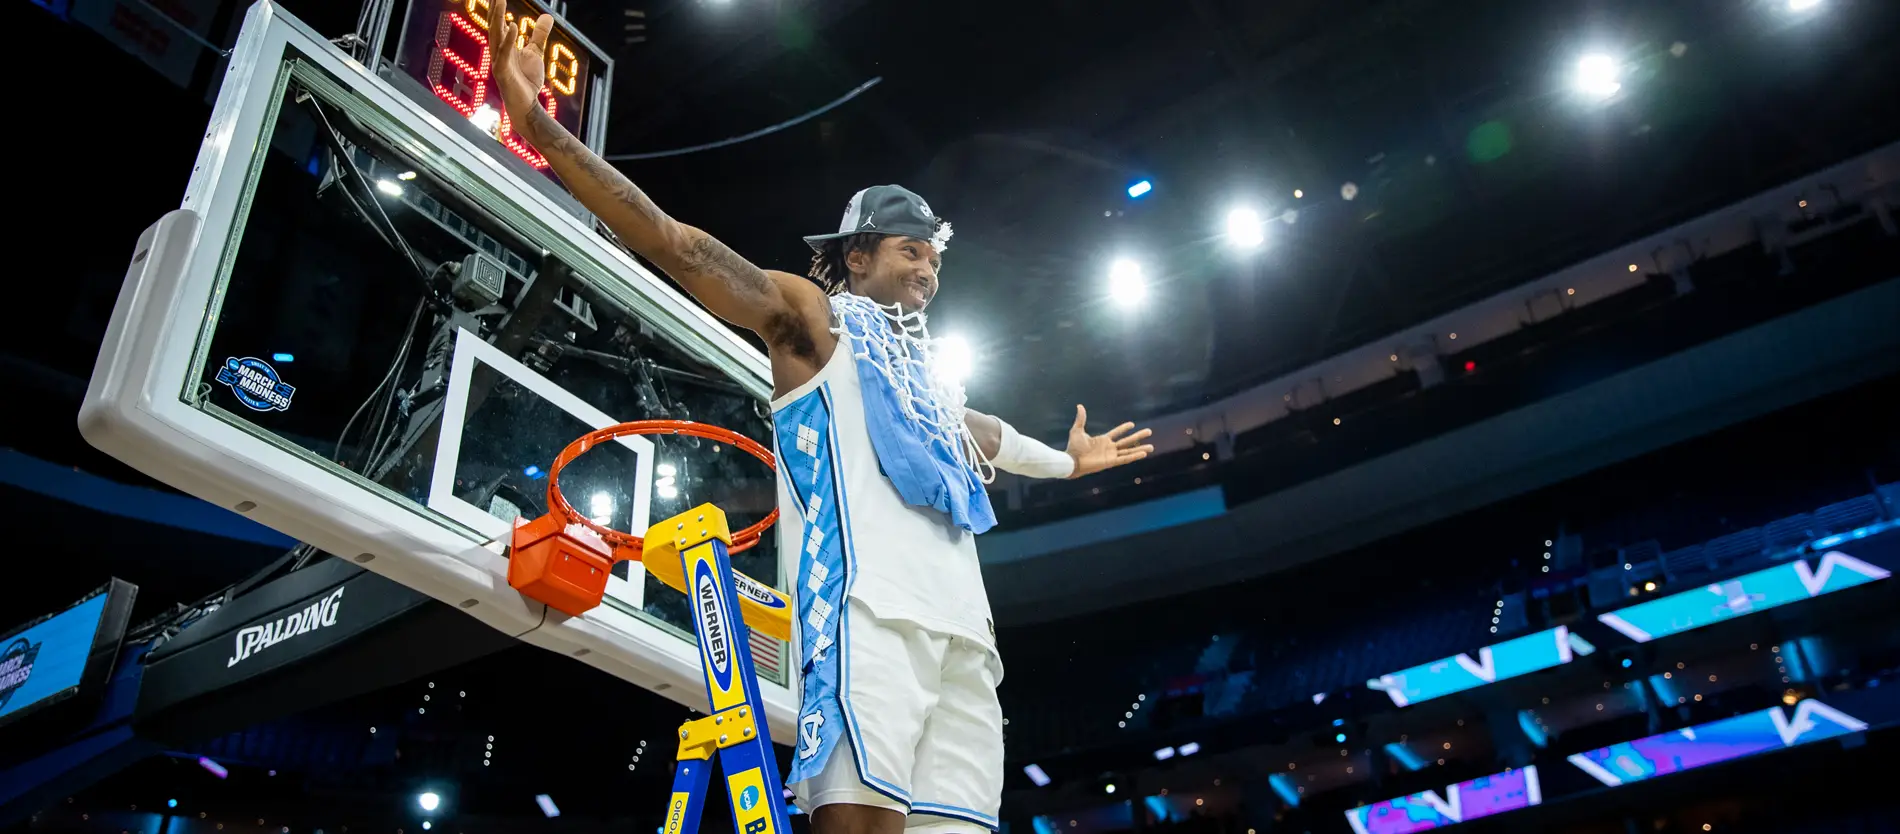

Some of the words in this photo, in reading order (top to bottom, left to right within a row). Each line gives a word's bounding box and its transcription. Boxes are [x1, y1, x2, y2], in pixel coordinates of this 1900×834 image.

[238, 364, 276, 390] MARCH
[239, 376, 289, 408] MADNESS
[733, 577, 770, 602] ERNER
[227, 586, 345, 668] SPALDING
[700, 583, 726, 665] WERNER
